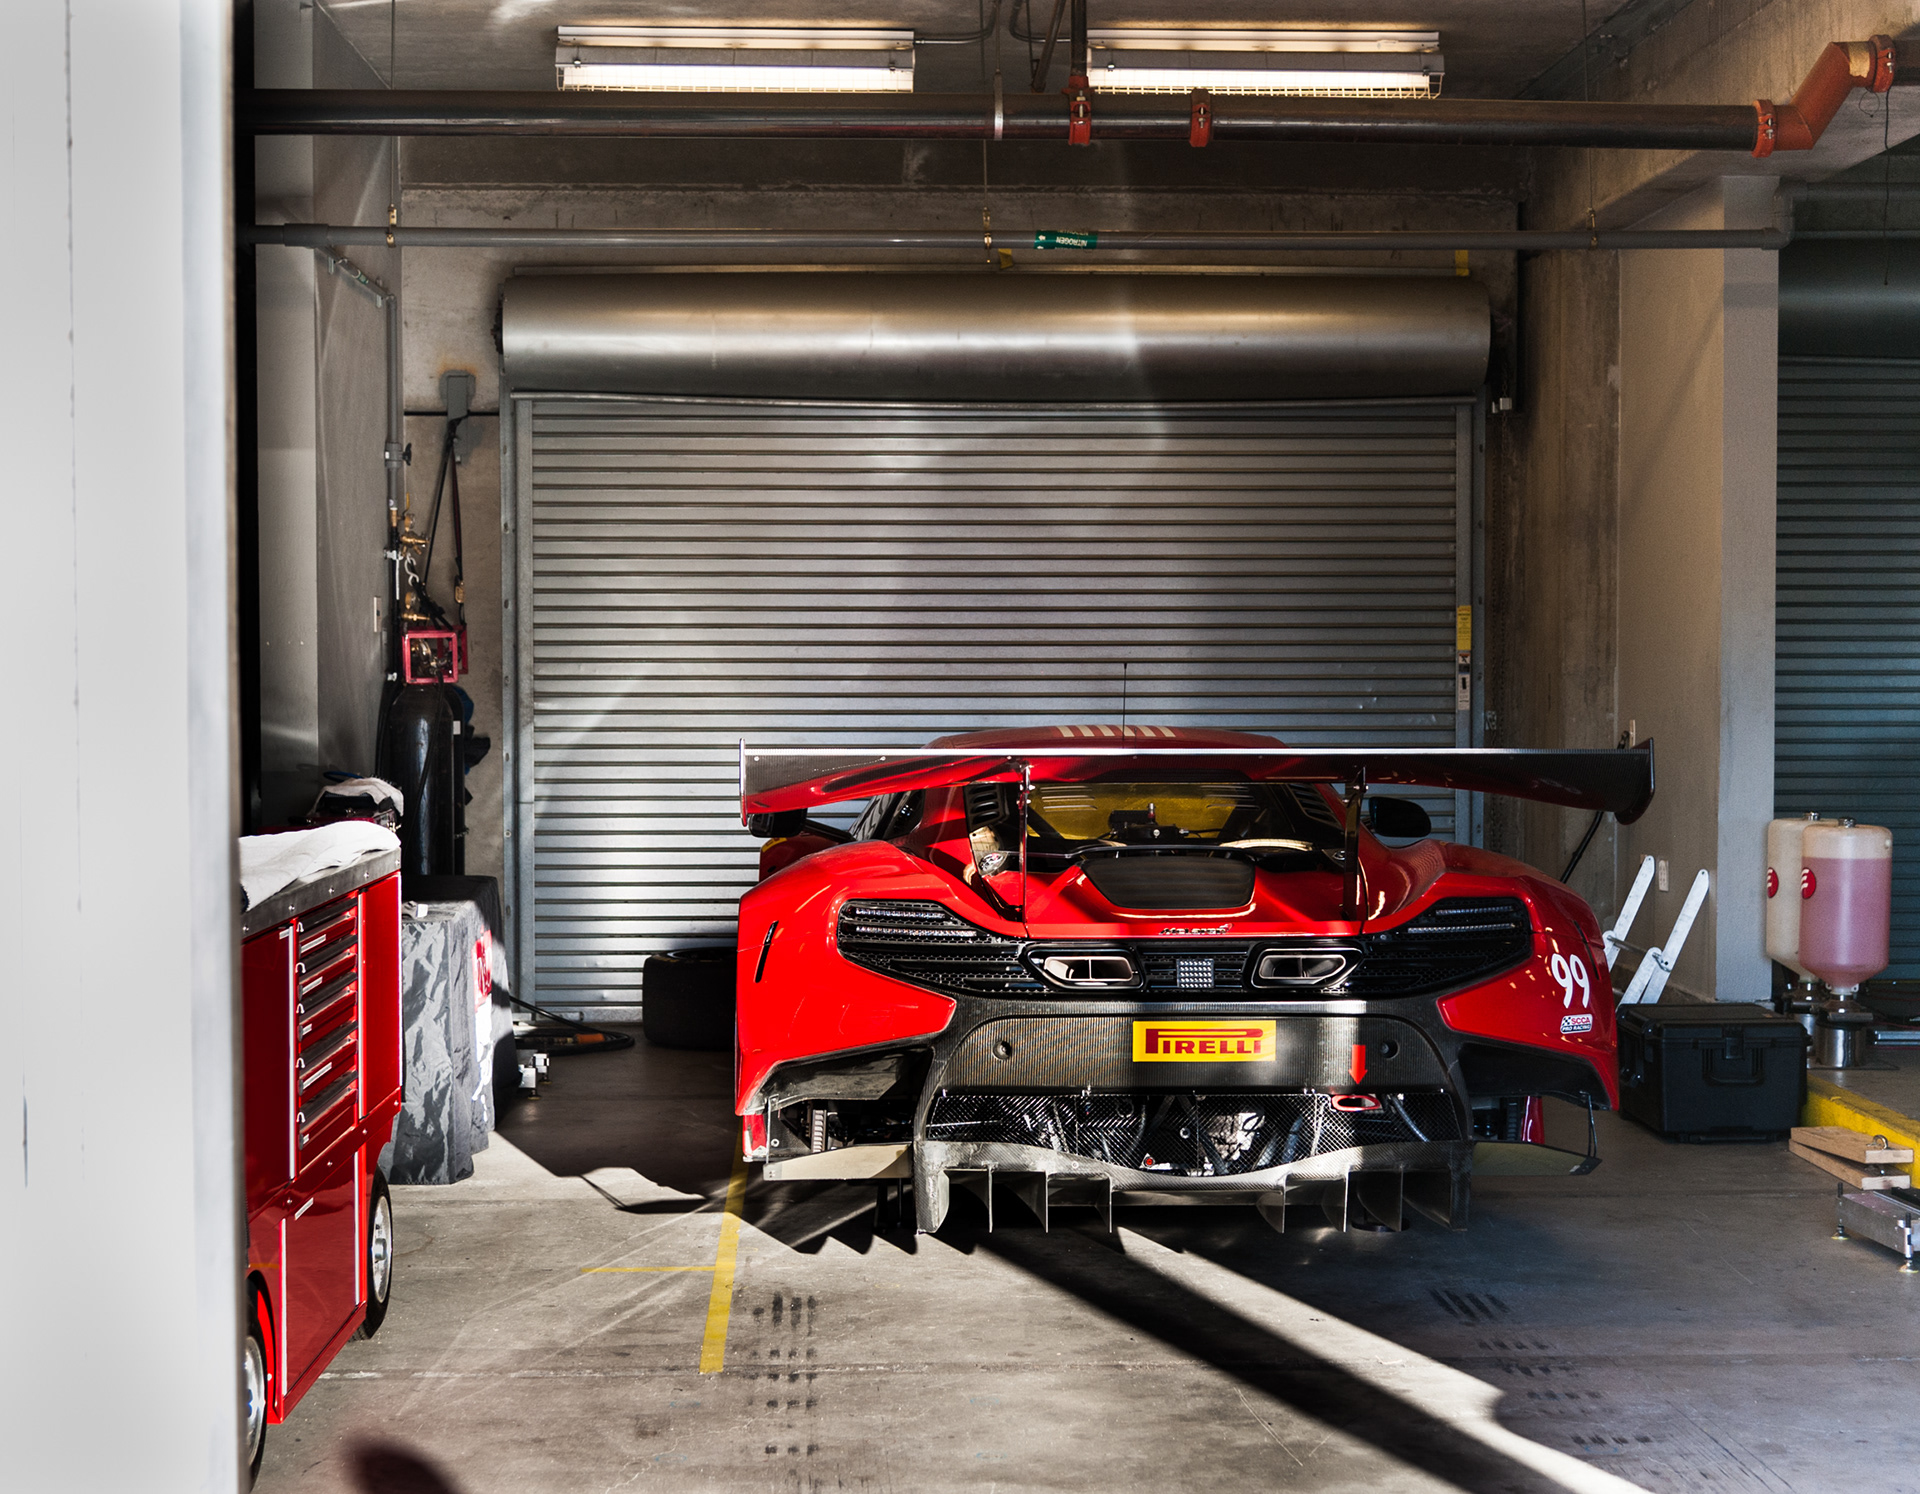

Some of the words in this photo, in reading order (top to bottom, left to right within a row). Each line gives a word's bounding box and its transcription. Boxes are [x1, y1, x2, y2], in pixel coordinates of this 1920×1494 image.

[1055, 236, 1088, 247] NITROGEN
[1551, 953, 1590, 1009] 99
[1571, 1016, 1590, 1025] SCCA
[1145, 1028, 1264, 1054] PIRELLI
